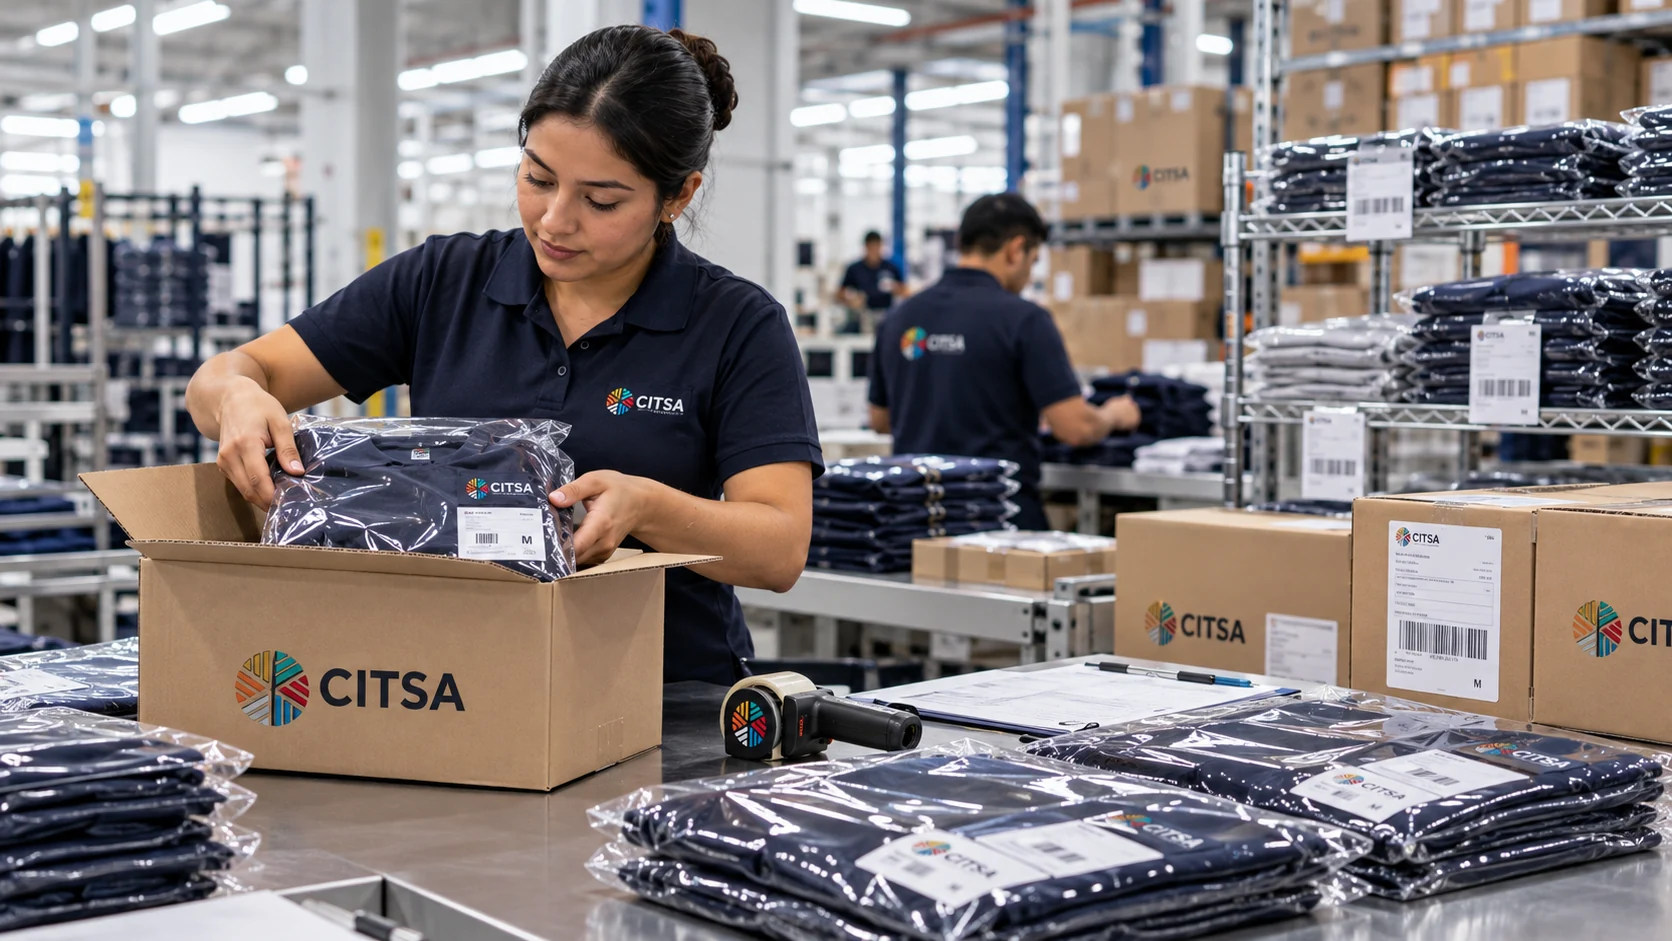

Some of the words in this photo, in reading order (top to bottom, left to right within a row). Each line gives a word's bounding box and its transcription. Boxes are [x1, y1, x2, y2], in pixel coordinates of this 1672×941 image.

[636, 395, 684, 412] CITSA
[490, 482, 534, 494] CITSA
[521, 535, 533, 545] M
[1412, 532, 1440, 544] CITSA
[1180, 613, 1246, 644] CITSA
[319, 667, 466, 712] CITSA
[1473, 679, 1482, 689] M
[1512, 750, 1571, 768] CITSA
[1361, 782, 1406, 800] CITSA
[1142, 823, 1204, 849] CITSA
